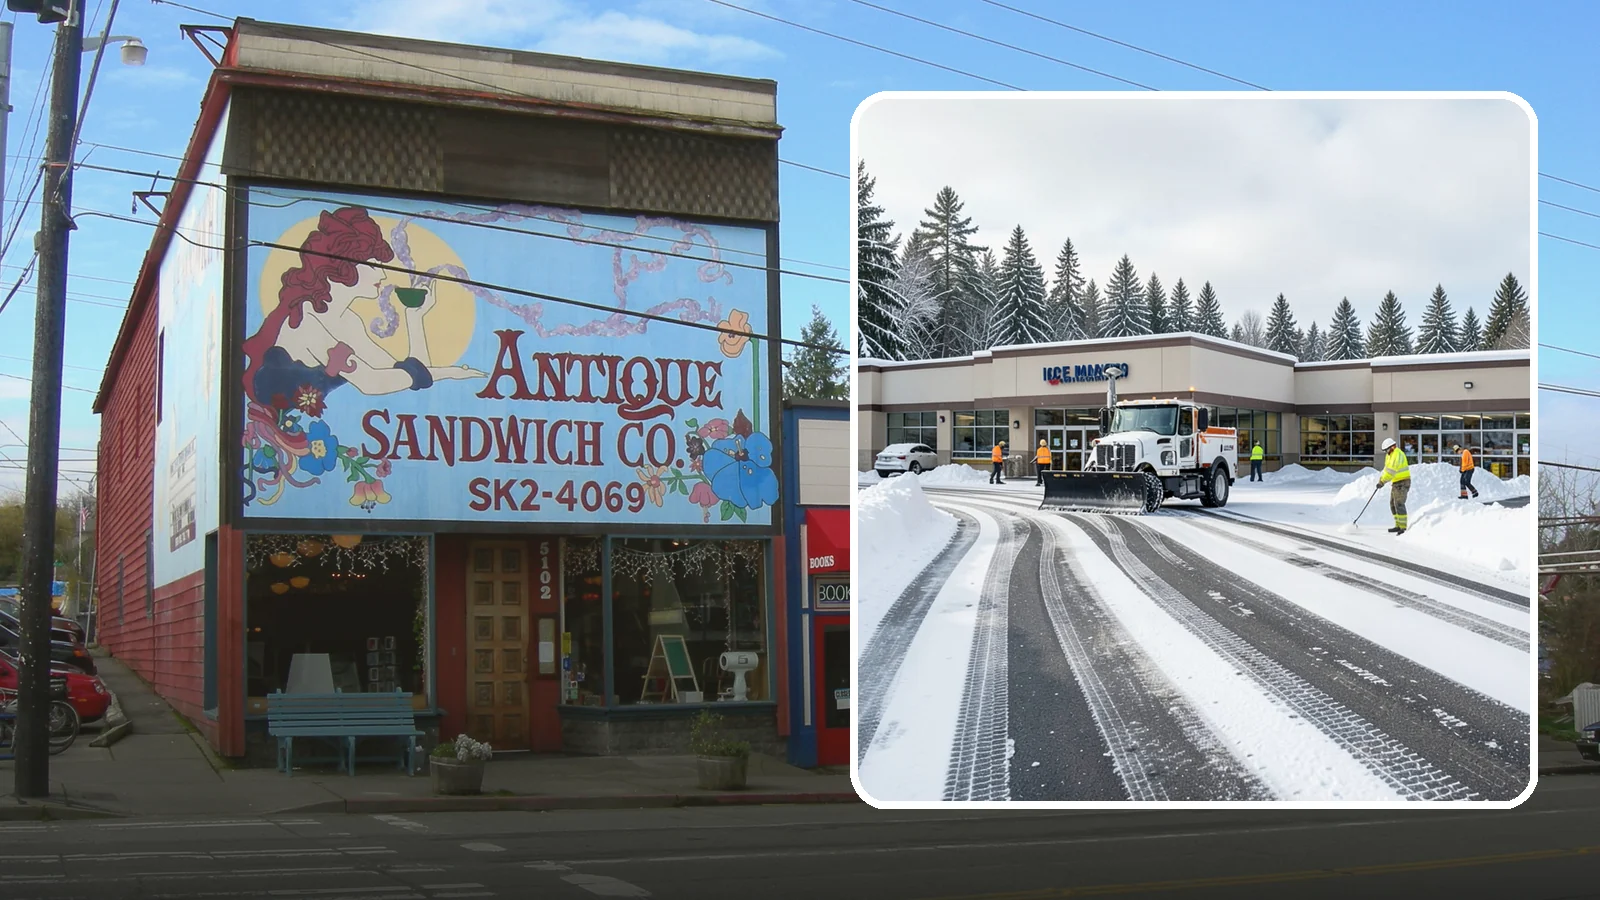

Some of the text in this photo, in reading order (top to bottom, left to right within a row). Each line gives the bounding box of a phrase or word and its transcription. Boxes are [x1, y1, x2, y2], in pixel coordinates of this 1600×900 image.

[476, 329, 723, 420] ANTIQUE
[361, 409, 684, 468] SANDWICH CO.
[468, 477, 646, 513] SK2-4069
[540, 542, 551, 599] 5102
[809, 555, 835, 569] BOOKS
